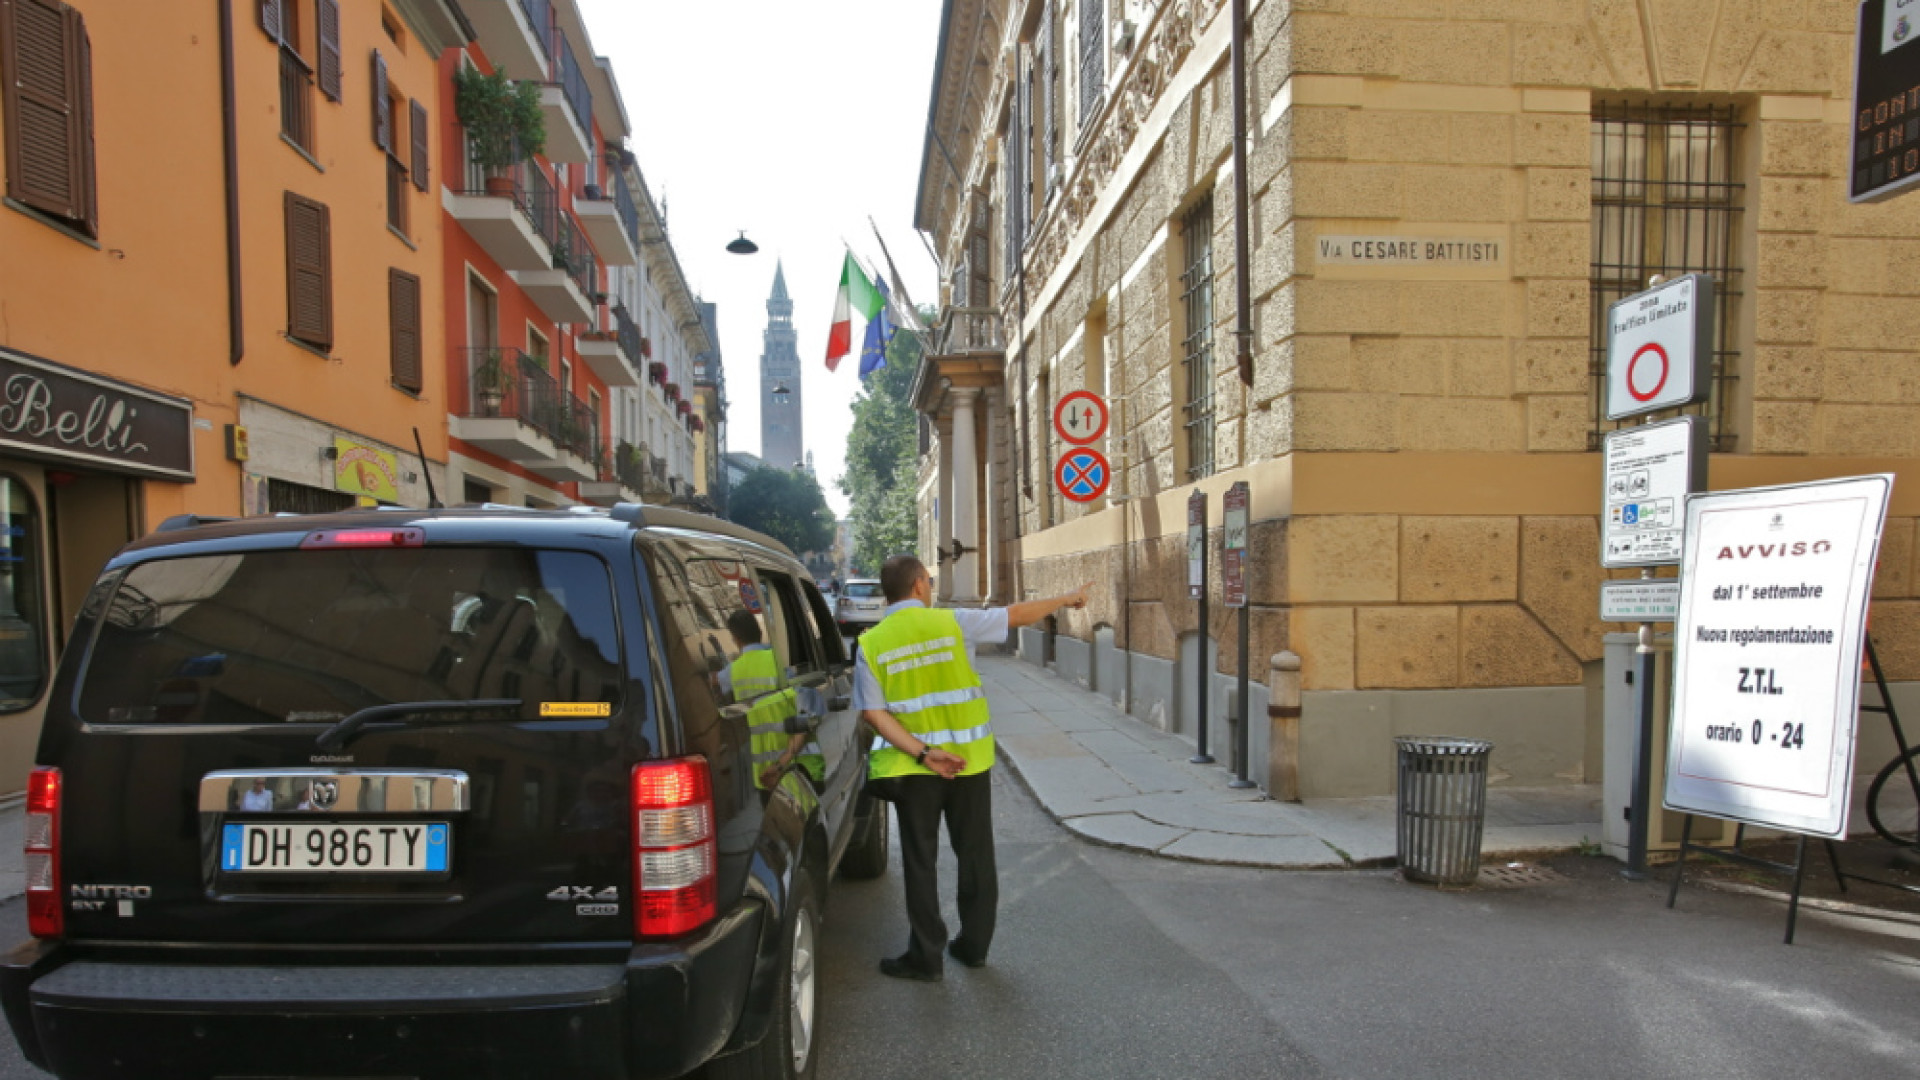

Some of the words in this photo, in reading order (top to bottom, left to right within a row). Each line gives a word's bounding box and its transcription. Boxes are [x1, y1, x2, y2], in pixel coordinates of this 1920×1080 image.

[1351, 241, 1418, 260] CESARE
[1425, 241, 1499, 261] BATTISTI
[1614, 315, 1646, 334] traffico
[0, 373, 149, 454] Belli
[1717, 540, 1831, 560] AVVISO
[1713, 585, 1733, 600] dal
[1752, 583, 1823, 600] settembre
[1696, 626, 1727, 642] Nuova
[1730, 626, 1834, 647] regolamentazione
[1738, 667, 1783, 695] Z.T.L.
[1706, 723, 1743, 743] orario
[1752, 719, 1762, 745] 0
[1781, 721, 1804, 750] 24
[248, 828, 291, 866] DH
[306, 828, 421, 867] 986TY
[71, 884, 152, 899] NITRO
